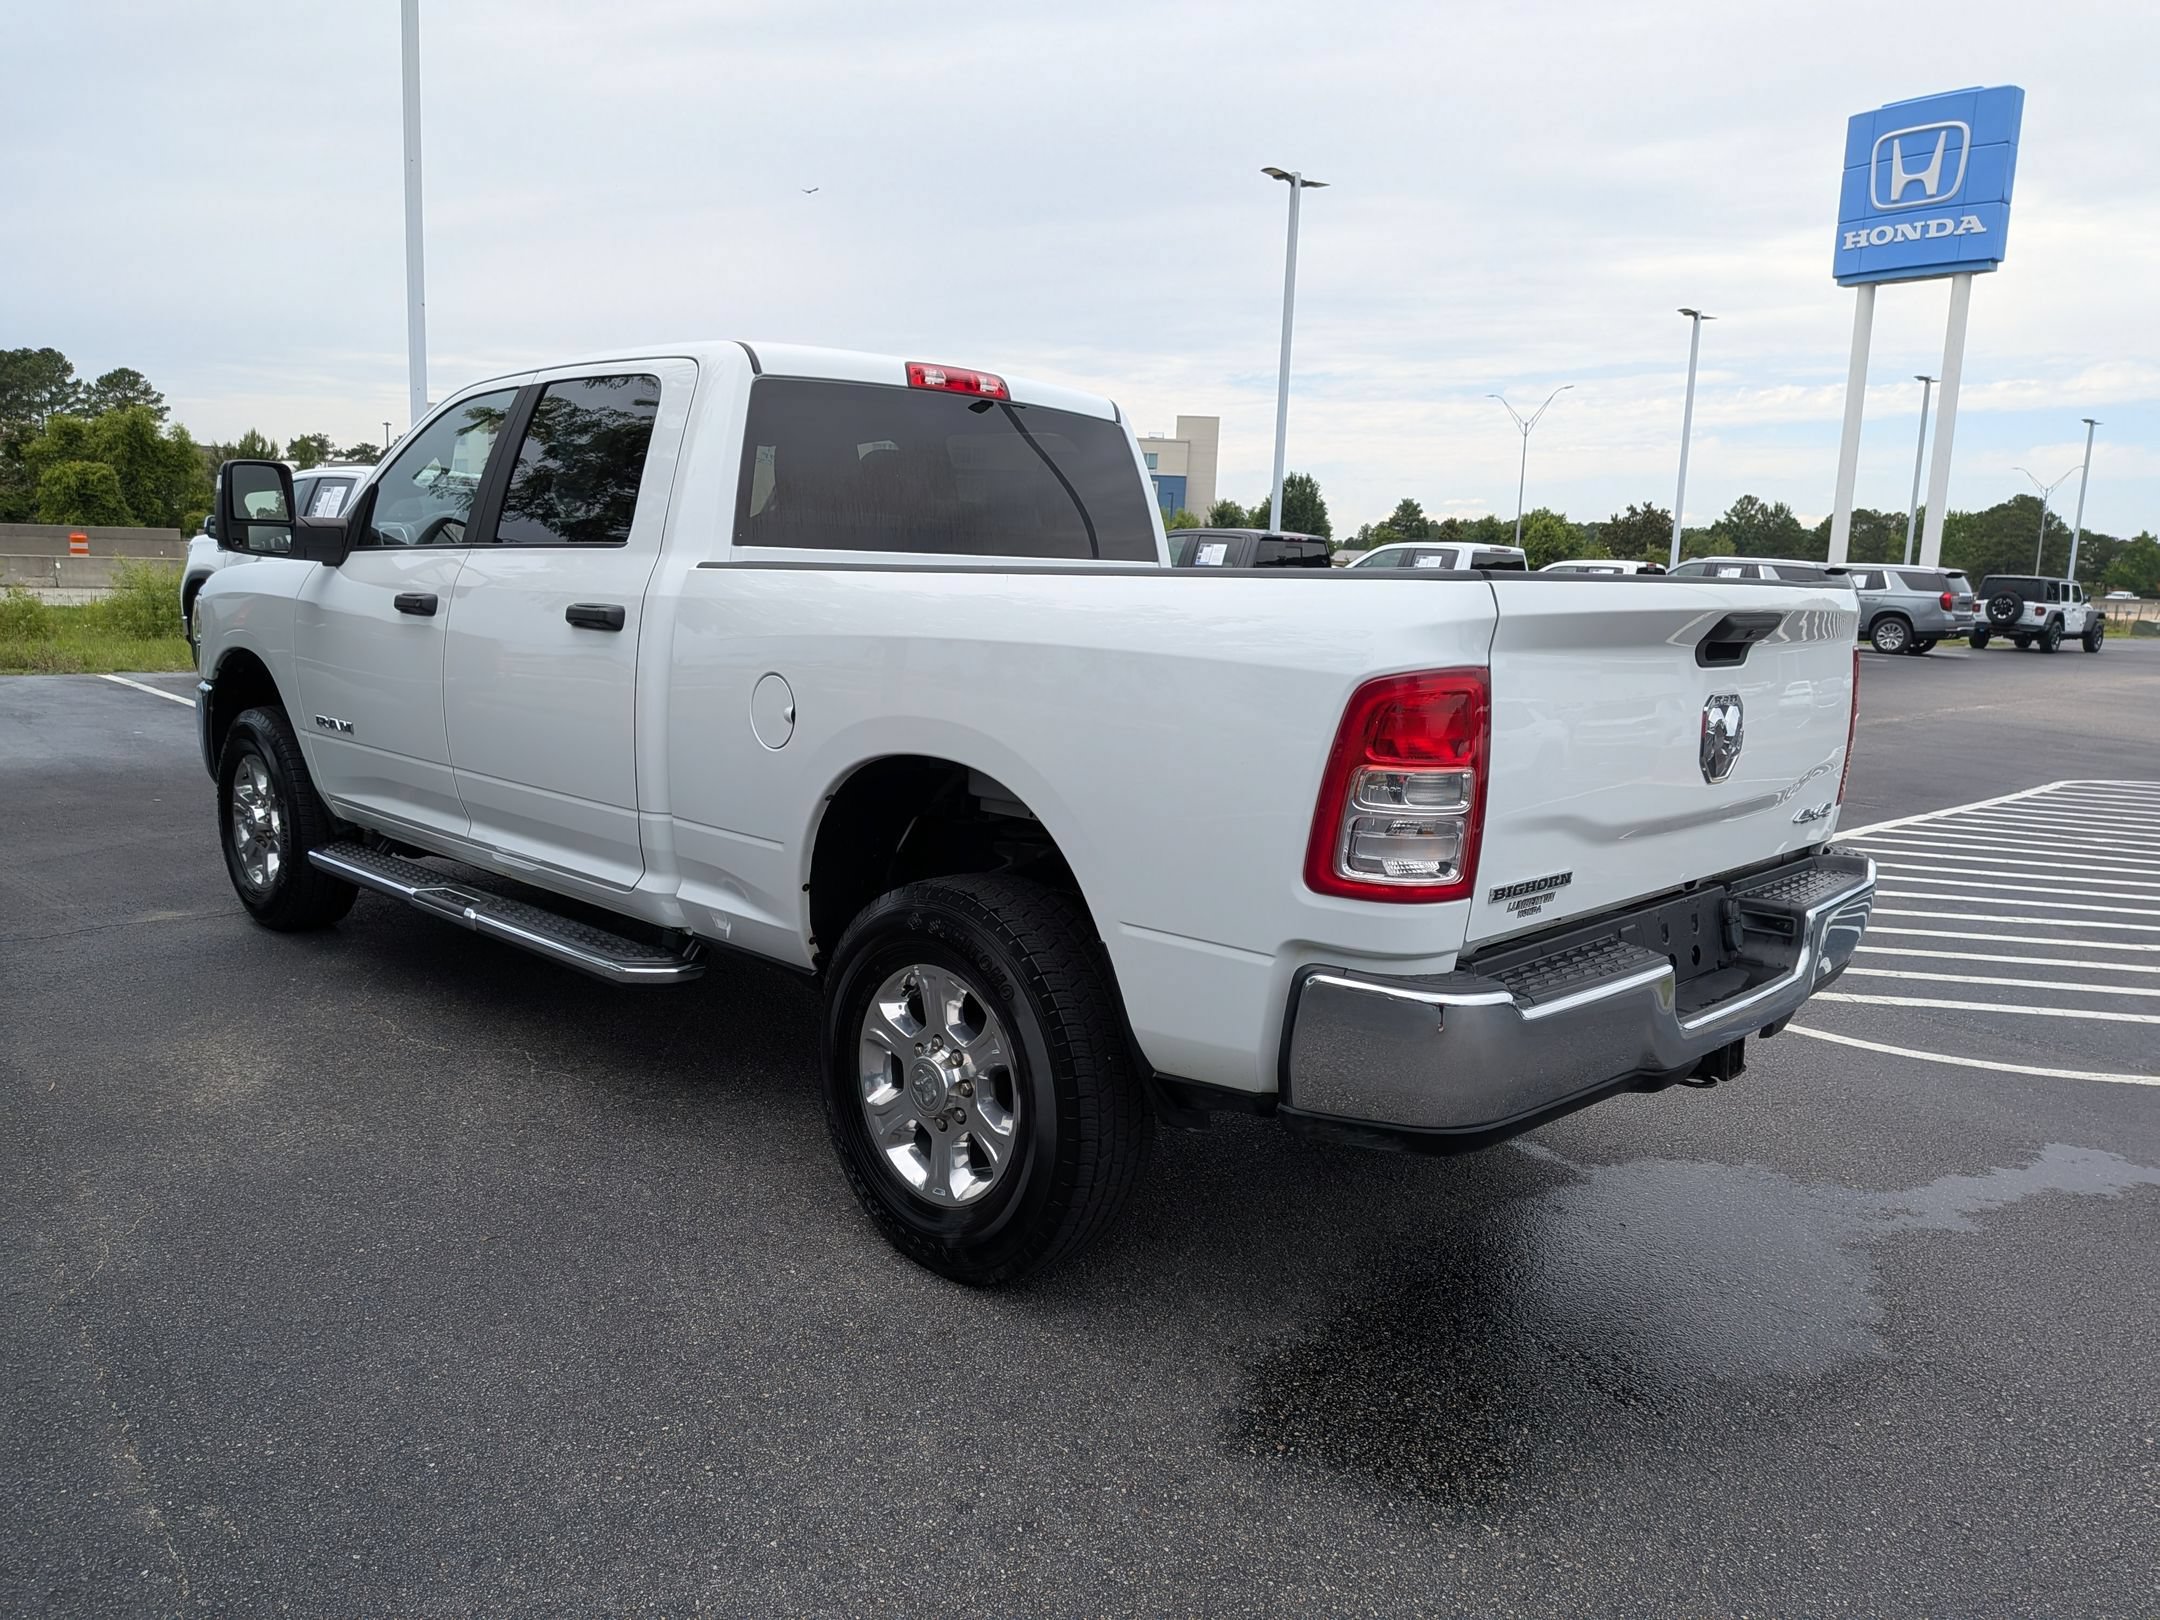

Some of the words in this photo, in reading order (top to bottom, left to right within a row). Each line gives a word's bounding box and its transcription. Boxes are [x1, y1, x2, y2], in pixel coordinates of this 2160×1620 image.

[1842, 215, 1987, 250] HONDA
[315, 714, 354, 735] RAM
[1491, 871, 1573, 902] BIGHORN
